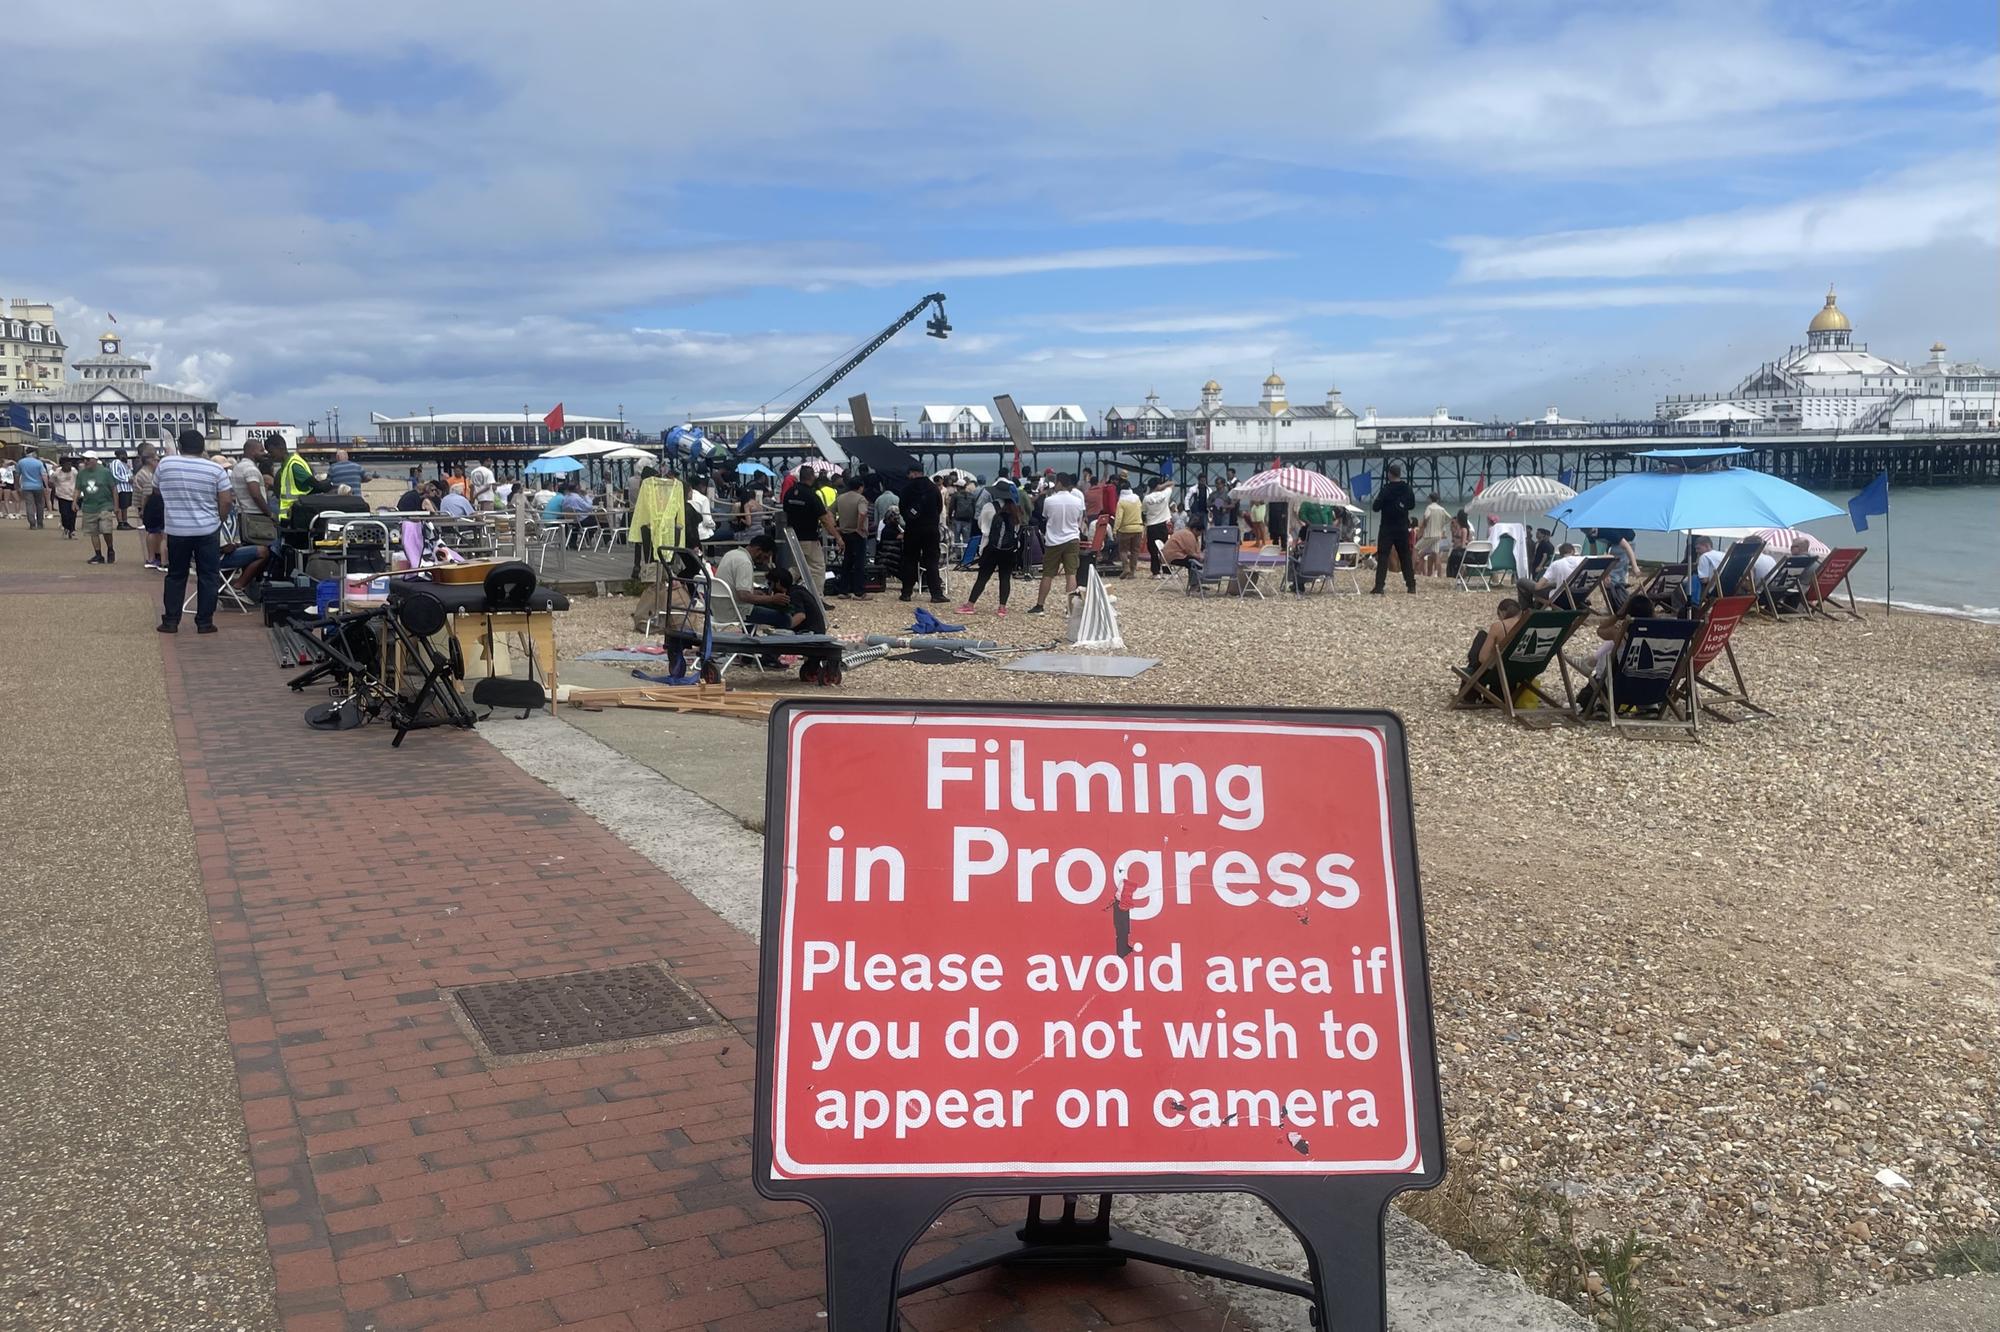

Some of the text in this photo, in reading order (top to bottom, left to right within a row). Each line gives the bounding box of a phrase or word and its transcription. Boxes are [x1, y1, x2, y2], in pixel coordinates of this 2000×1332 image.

[1713, 623, 1733, 632] Your
[926, 738, 1265, 831] Filming
[826, 826, 1361, 921] in Progress
[802, 941, 1388, 995] Please avoid area if
[810, 1008, 1379, 1071] you do not wish to
[814, 1089, 1380, 1140] appear on camera
